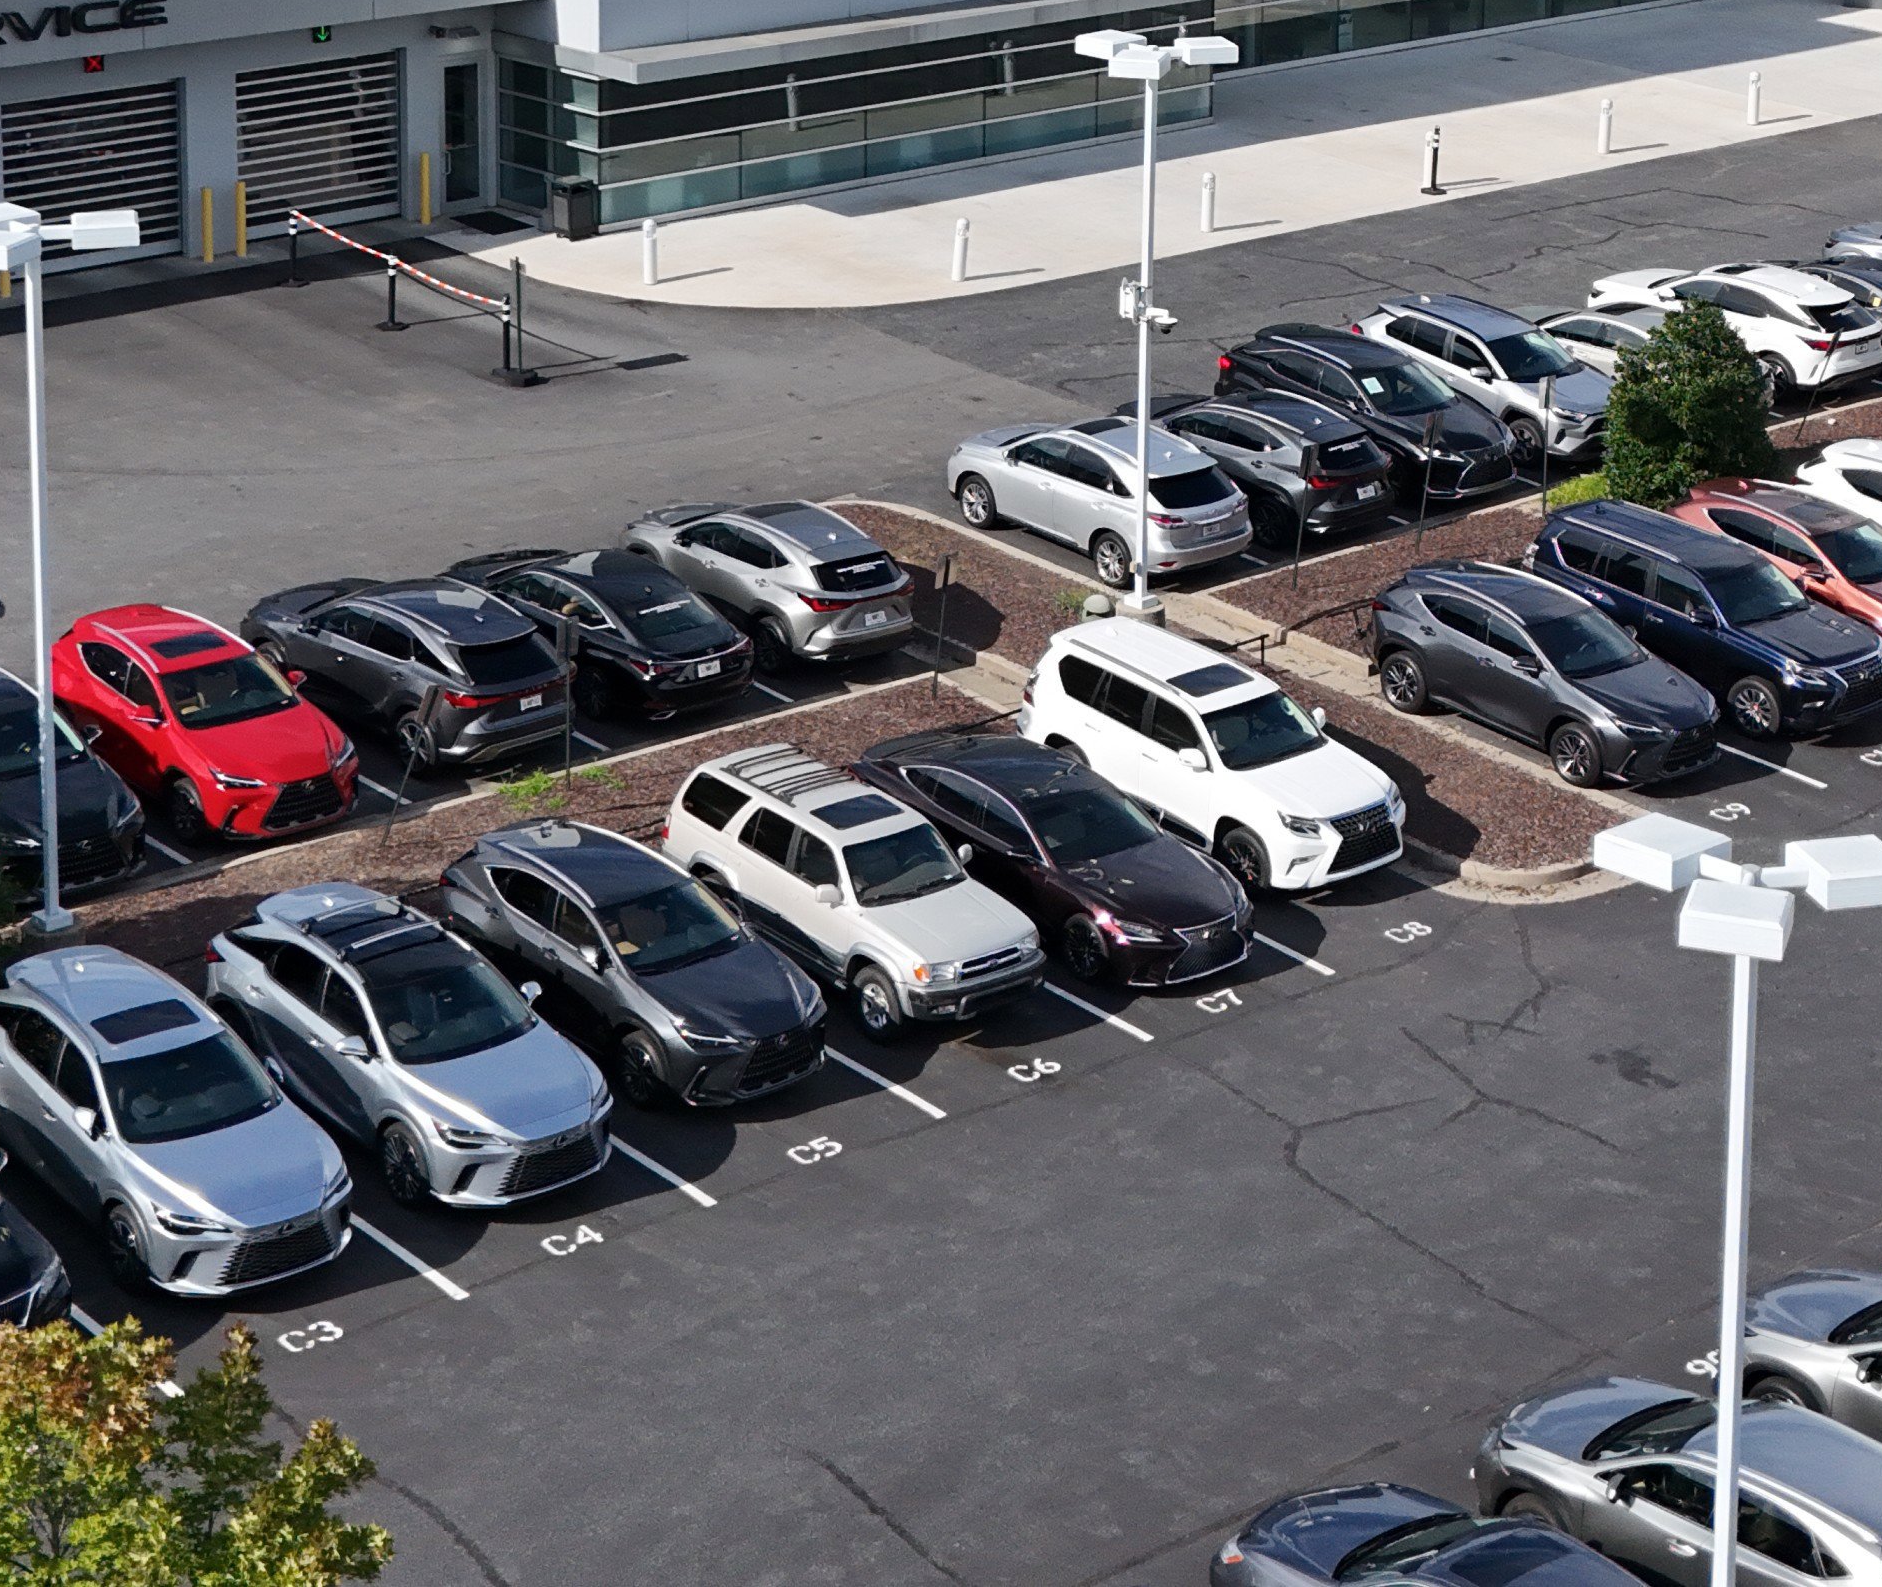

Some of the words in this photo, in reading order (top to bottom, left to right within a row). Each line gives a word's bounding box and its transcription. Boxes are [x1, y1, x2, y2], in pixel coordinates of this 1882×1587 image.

[1709, 802, 1752, 823] C9
[1383, 920, 1434, 944] C8
[1195, 987, 1245, 1014] C7
[1006, 1057, 1063, 1083] C6
[786, 1135, 844, 1166] C5
[539, 1223, 605, 1257] C4
[276, 1319, 345, 1354] C3
